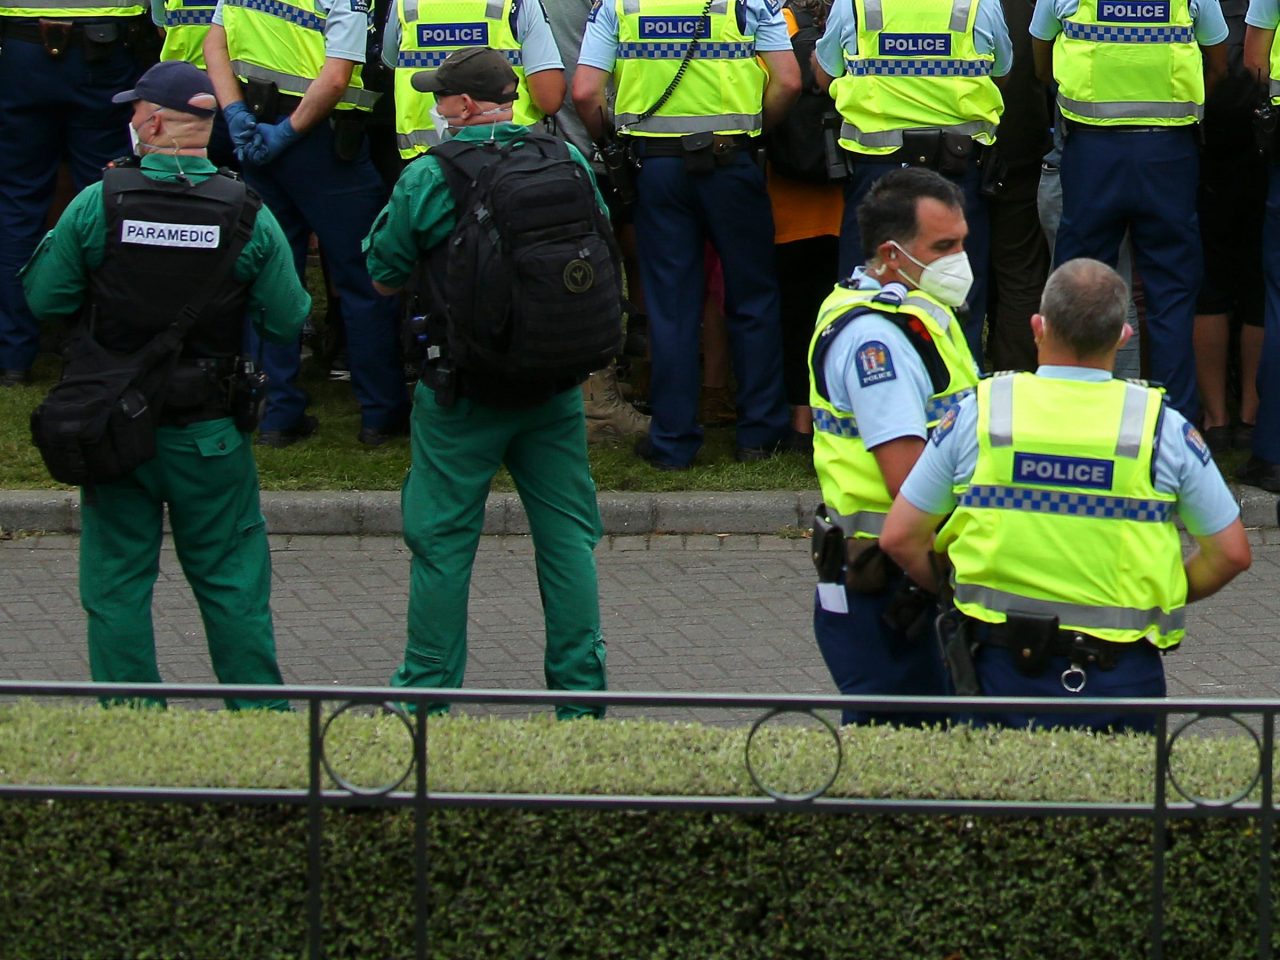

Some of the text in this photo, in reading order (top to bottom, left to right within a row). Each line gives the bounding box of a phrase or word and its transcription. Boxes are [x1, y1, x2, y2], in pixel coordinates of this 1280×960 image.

[1103, 4, 1164, 18] POLICE
[422, 28, 483, 42] POLICE
[884, 38, 945, 51] POLICE
[127, 225, 215, 243] PARAMEDIC
[863, 371, 892, 384] POLICE
[1020, 459, 1106, 483] POLICE
